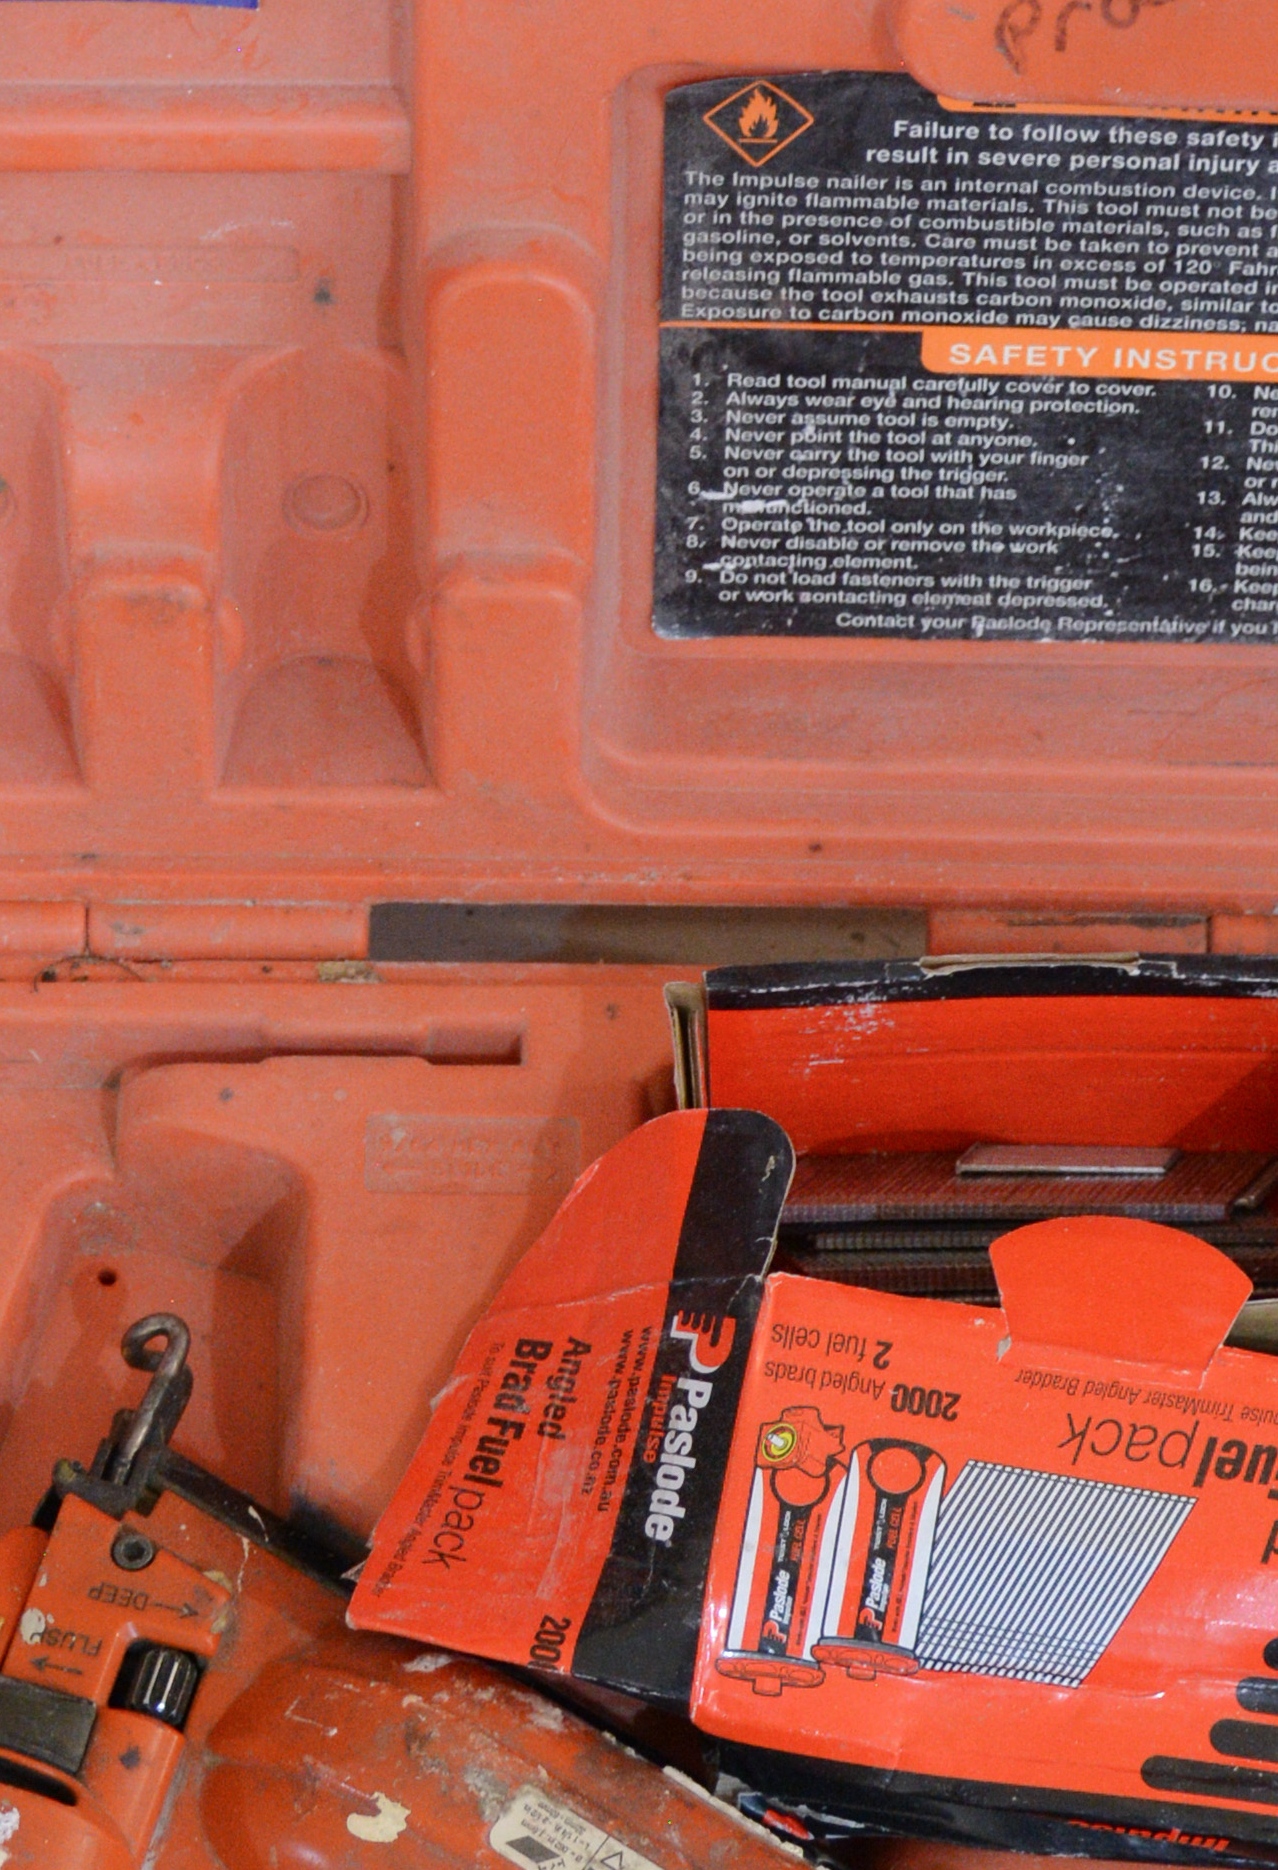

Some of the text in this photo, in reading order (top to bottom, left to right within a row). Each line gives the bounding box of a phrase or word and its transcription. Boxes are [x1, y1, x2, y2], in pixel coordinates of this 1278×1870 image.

[894, 120, 980, 141] Failure
[989, 124, 1015, 142] to
[1023, 124, 1100, 144] follow
[1109, 126, 1179, 146] these
[1187, 130, 1264, 151] safety
[866, 147, 938, 165] result
[946, 147, 970, 164] in
[978, 152, 1061, 168] severe
[1070, 152, 1180, 172] personal
[1188, 154, 1259, 177] injury
[684, 171, 725, 188] The
[733, 172, 819, 191] Impulse
[827, 174, 888, 191] nailer
[896, 176, 914, 191] is
[921, 179, 947, 192] an
[956, 177, 1038, 194] internal
[1046, 181, 1175, 199] combustion
[1183, 184, 1261, 201] device.
[949, 343, 1097, 368] SAFETY
[692, 374, 1157, 397] 1. Read tool manual carefully cover to cover.
[690, 410, 1014, 431] 3. Never assume tool is empty.
[836, 612, 966, 633] Contact your
[771, 1323, 893, 1369] 2 fuel cells
[494, 1338, 553, 1413] Brad
[538, 1336, 592, 1442] Angled
[764, 1360, 961, 1421] 2000 Angled brads
[1015, 1367, 1080, 1396] Bradder
[1084, 1377, 1141, 1406] Angled
[581, 1329, 633, 1495] www.paslode.co.nz
[597, 1325, 652, 1512] www.paslode.com.au
[642, 1373, 677, 1463] Impulse
[1148, 1388, 1236, 1420] TrimMaster
[644, 1378, 714, 1543] Paslode
[88, 1582, 149, 1611] DEEP
[769, 1570, 790, 1622] Paslode
[865, 1557, 886, 1609] Paslode
